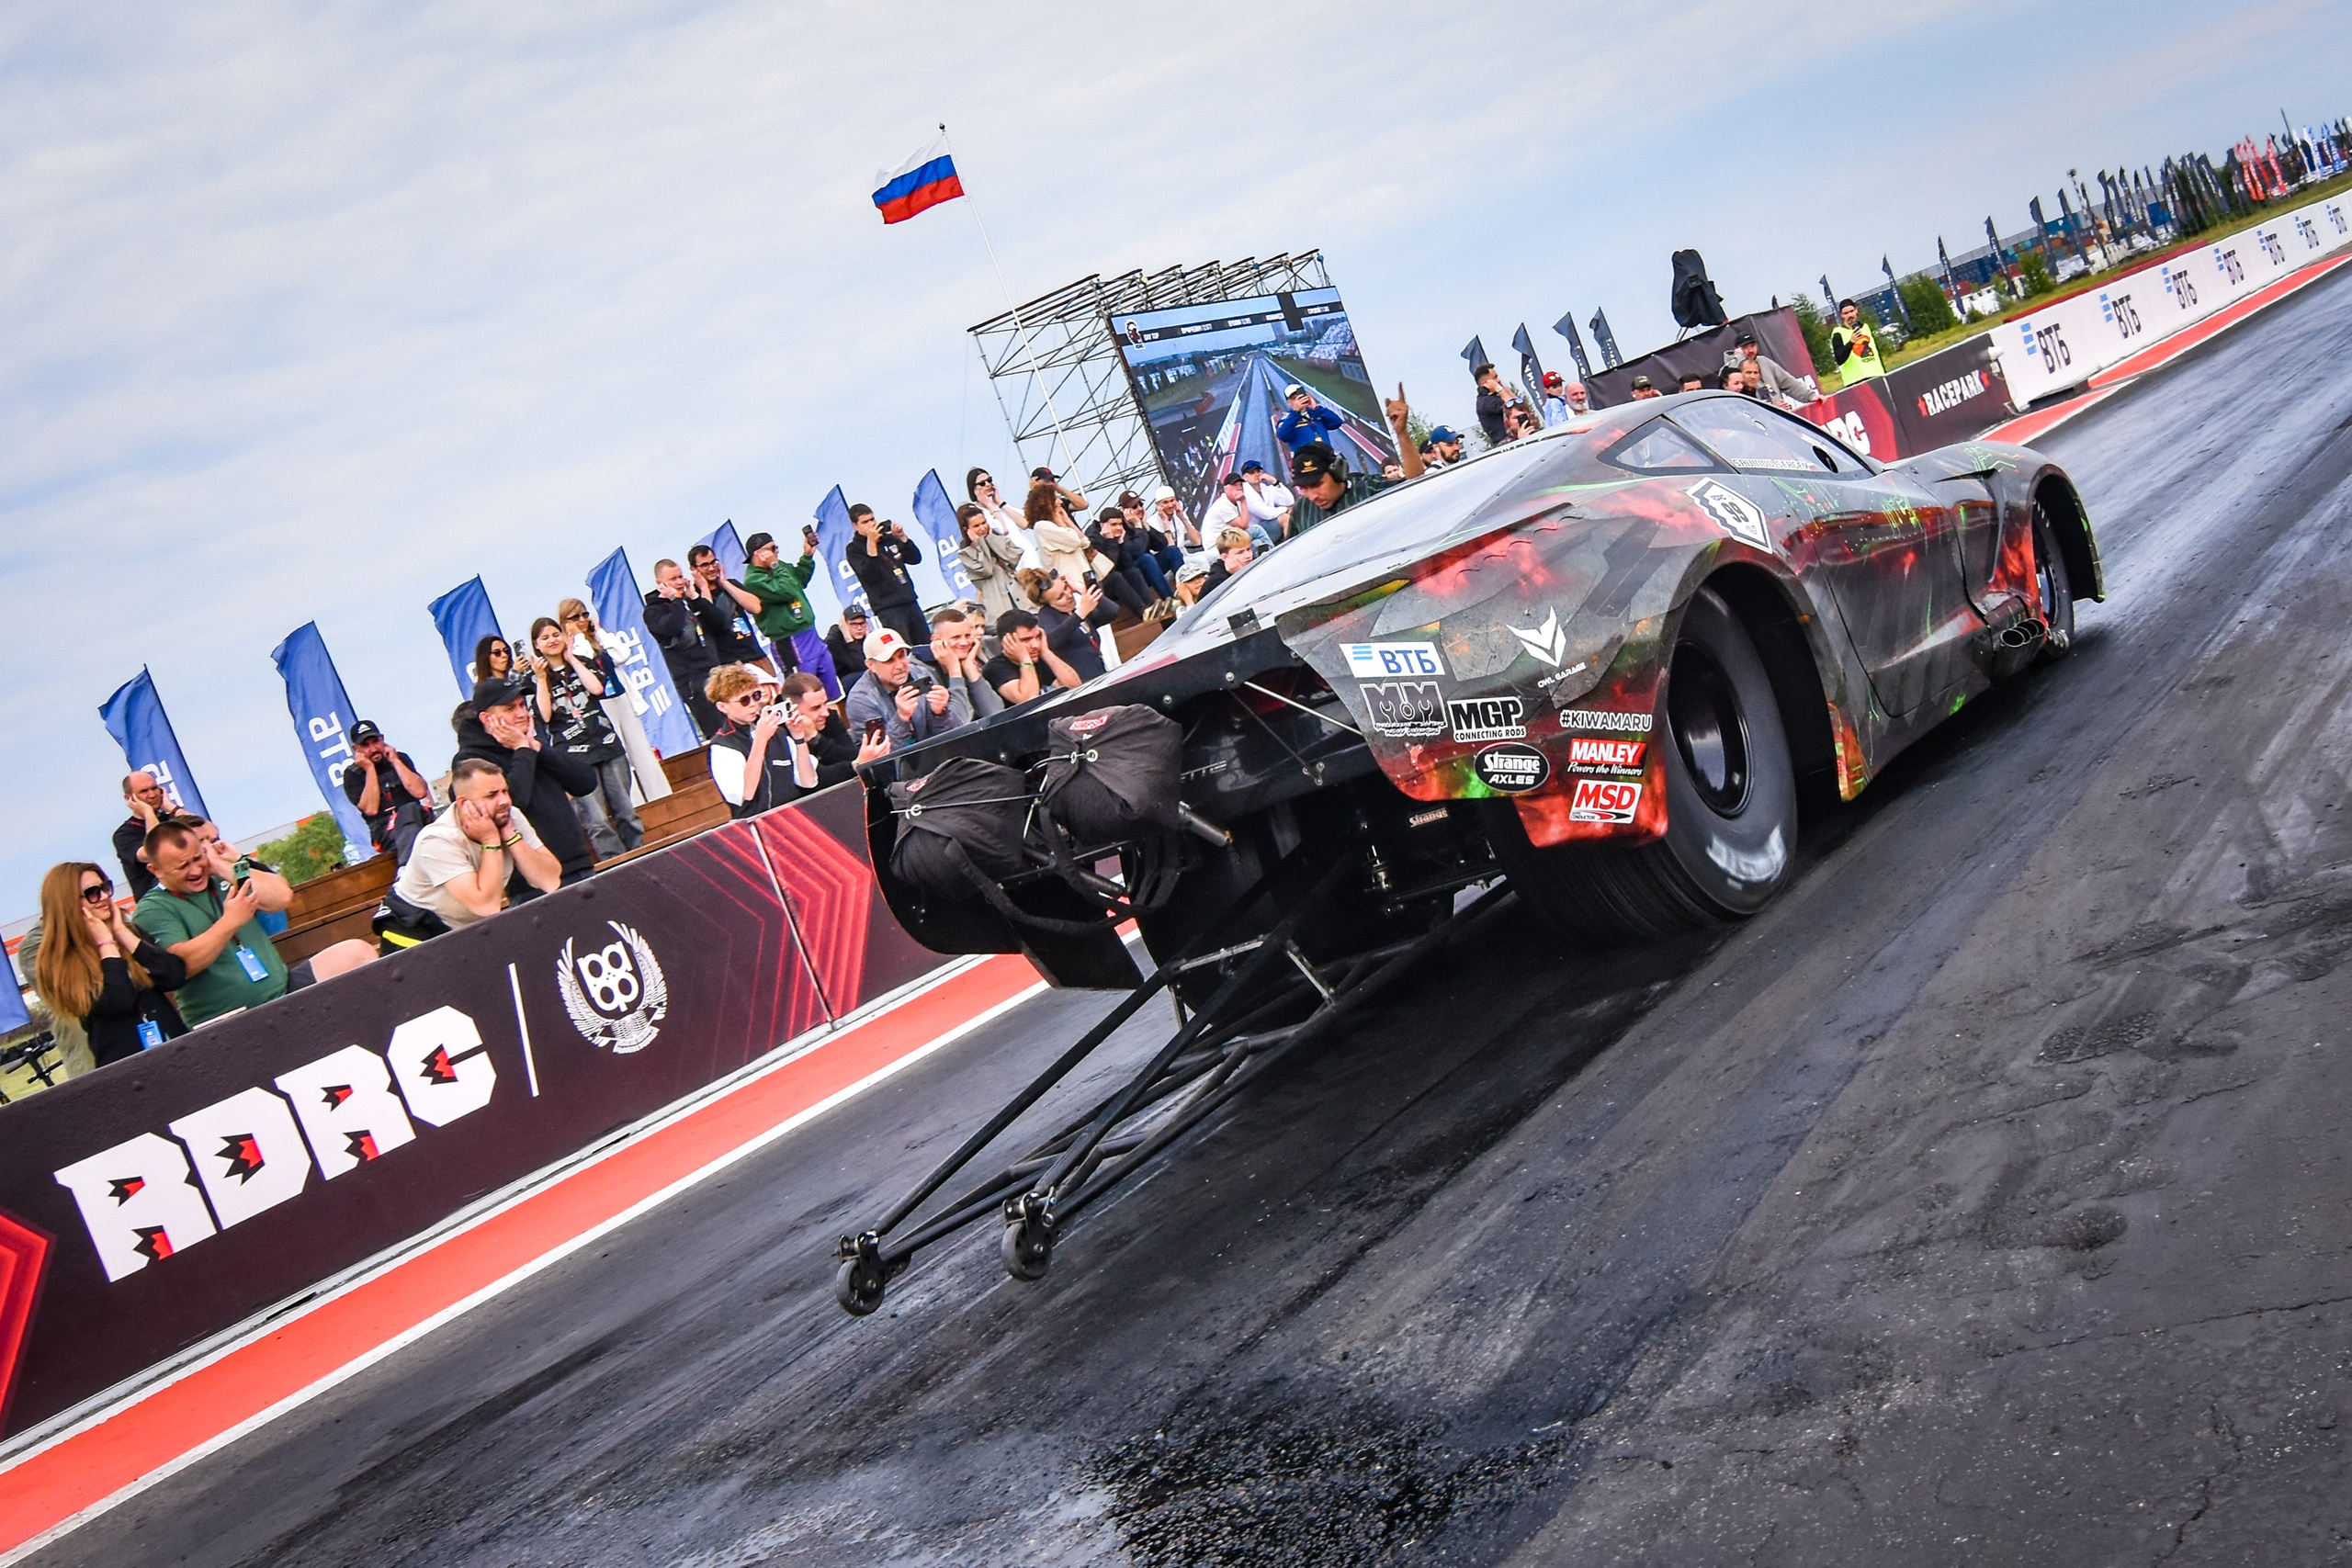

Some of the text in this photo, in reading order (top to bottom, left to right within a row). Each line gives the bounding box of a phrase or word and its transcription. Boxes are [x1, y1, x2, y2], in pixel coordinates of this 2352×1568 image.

[2265, 233, 2285, 265] ВТБ
[2222, 249, 2245, 286] ВТБ
[2172, 270, 2198, 310] ВТБ
[2112, 294, 2142, 339] ВТБ
[2036, 323, 2071, 374] ВТБ
[1922, 369, 1984, 416] RACEPARK
[616, 626, 656, 691] ВТБ
[1378, 649, 1436, 673] ВТБ
[1537, 661, 1587, 688] OWL GARAGE
[1451, 700, 1521, 731] MGP
[1561, 712, 1652, 731] #KIWAMARU
[1455, 728, 1525, 741] CONNECTING RODS
[1483, 751, 1541, 773] Strange
[1571, 740, 1639, 763] MANLEY
[1488, 774, 1535, 785] AXLES
[1567, 761, 1643, 776] Powers the Winners
[1575, 784, 1636, 810] MSD
[53, 1005, 497, 1283] RDRC
